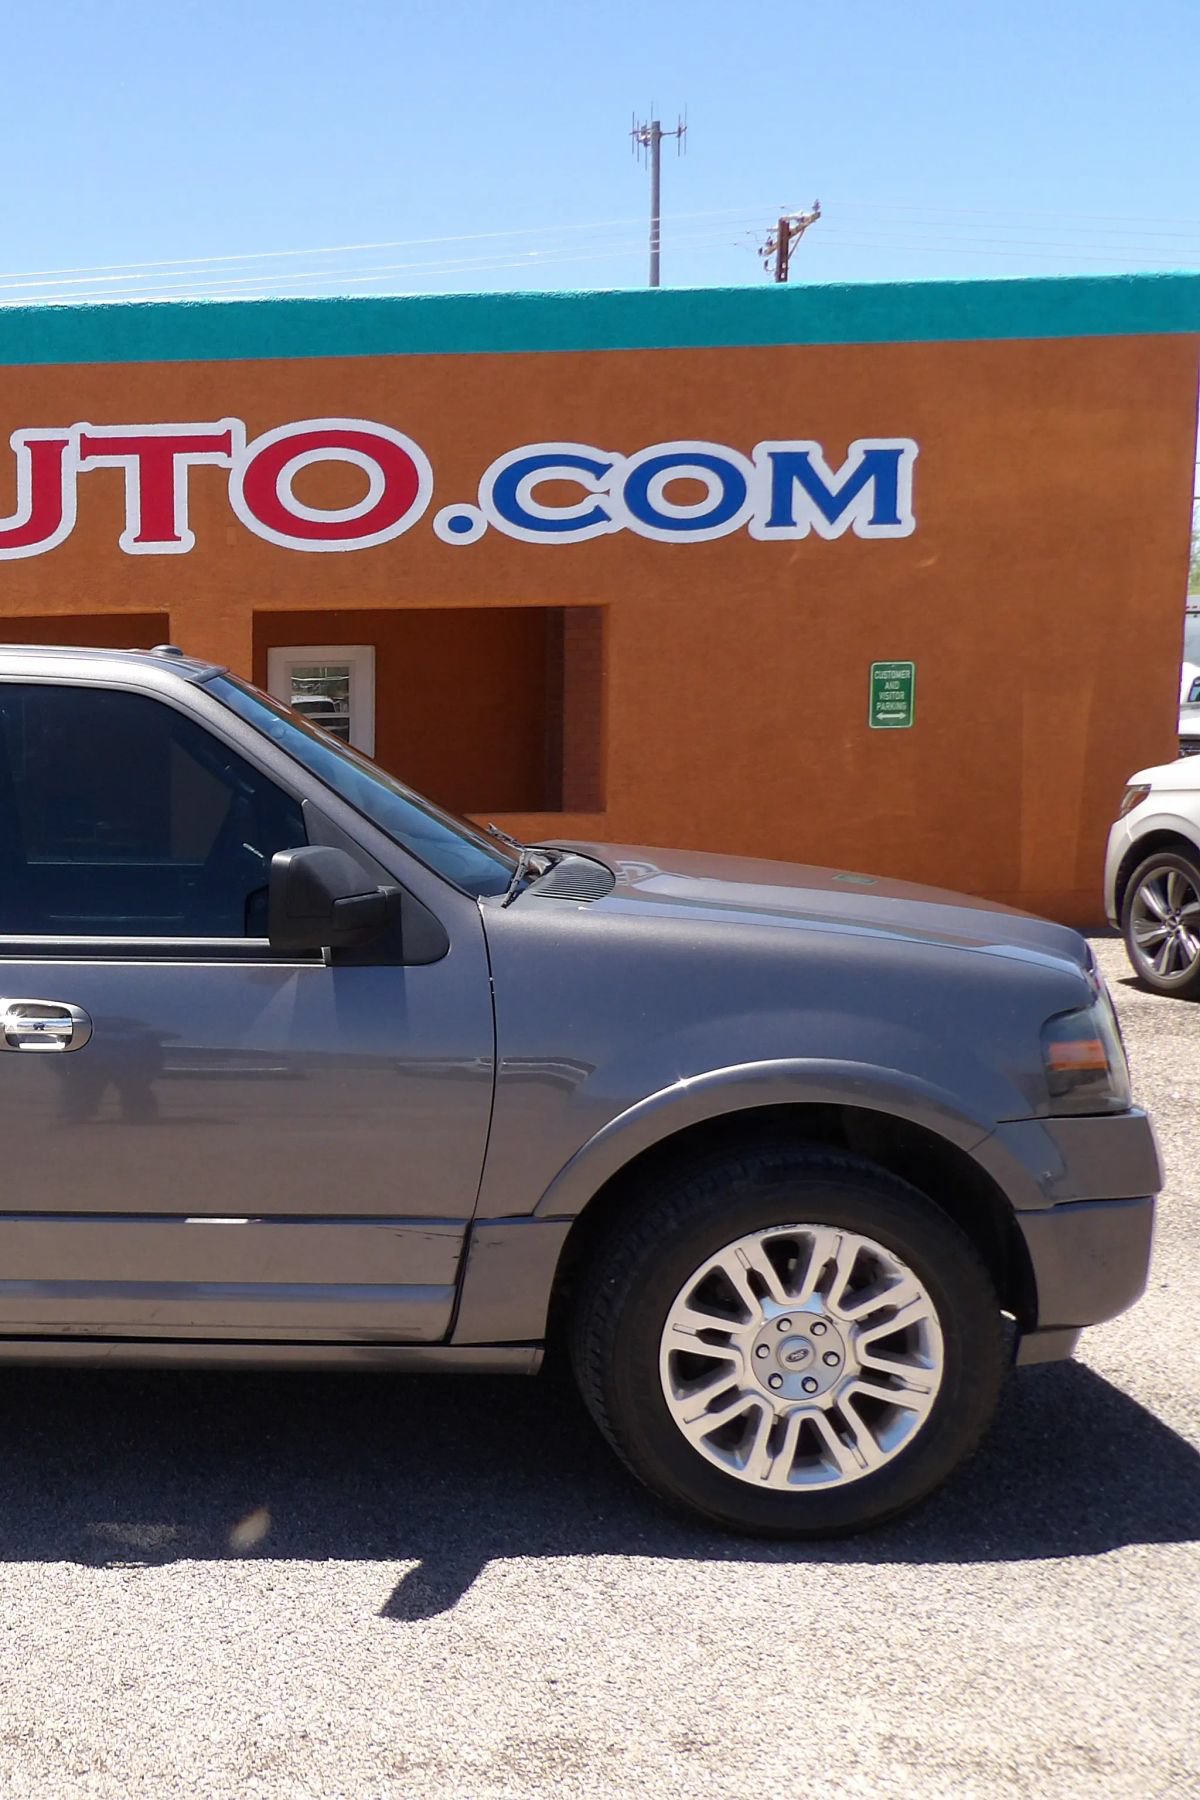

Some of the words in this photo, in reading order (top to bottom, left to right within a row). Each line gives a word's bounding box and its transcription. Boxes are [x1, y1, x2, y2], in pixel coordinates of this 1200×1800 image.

[874, 670, 911, 679] CUSTOMER
[884, 681, 900, 690] AND
[878, 691, 905, 700] VISITOR
[876, 702, 907, 711] PARKING
